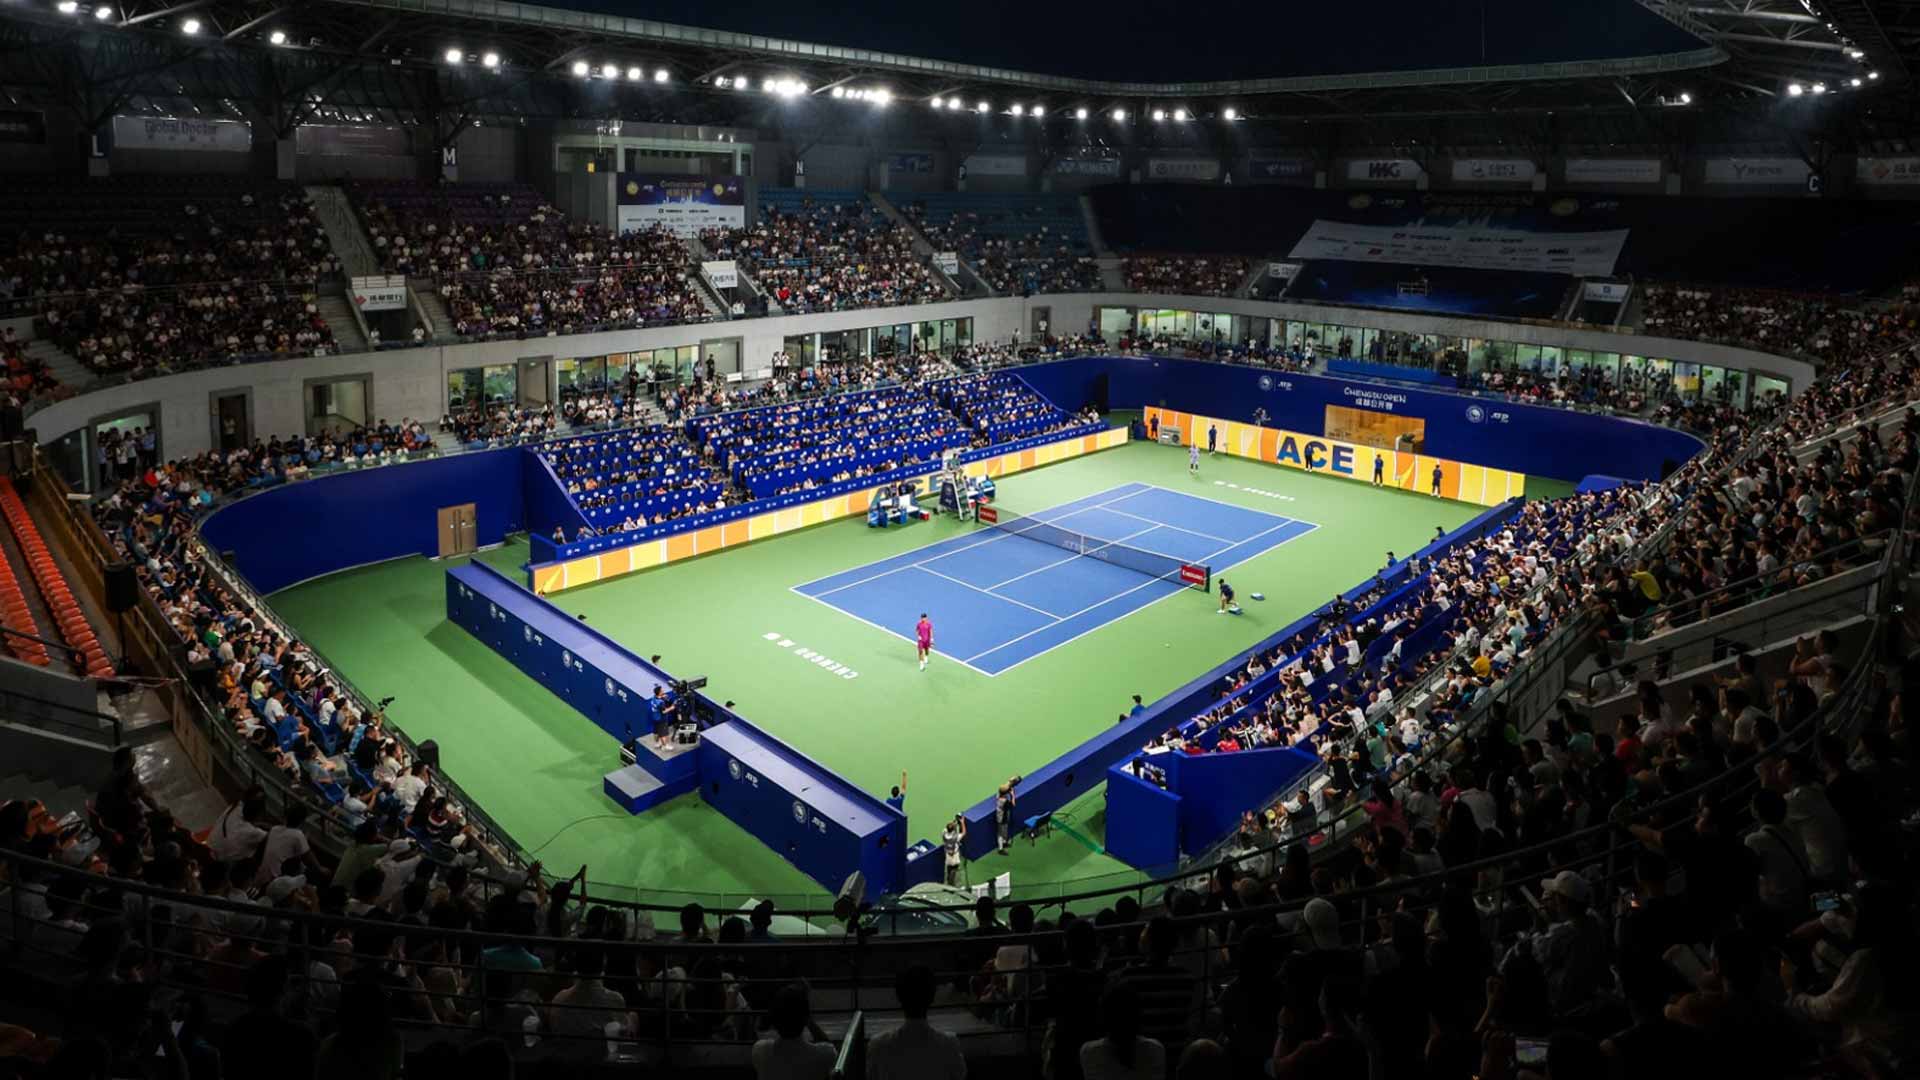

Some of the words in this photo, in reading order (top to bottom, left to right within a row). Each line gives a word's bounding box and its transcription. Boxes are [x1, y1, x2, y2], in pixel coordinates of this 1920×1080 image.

[91, 135, 104, 157] L
[443, 147, 456, 165] M
[796, 160, 804, 175] N
[1224, 171, 1232, 184] A
[1808, 176, 1819, 191] C
[1343, 387, 1383, 401] CHENGDU
[1383, 392, 1407, 404] OPEN
[1277, 435, 1354, 474] ACE
[794, 647, 859, 679] CHENGDU
